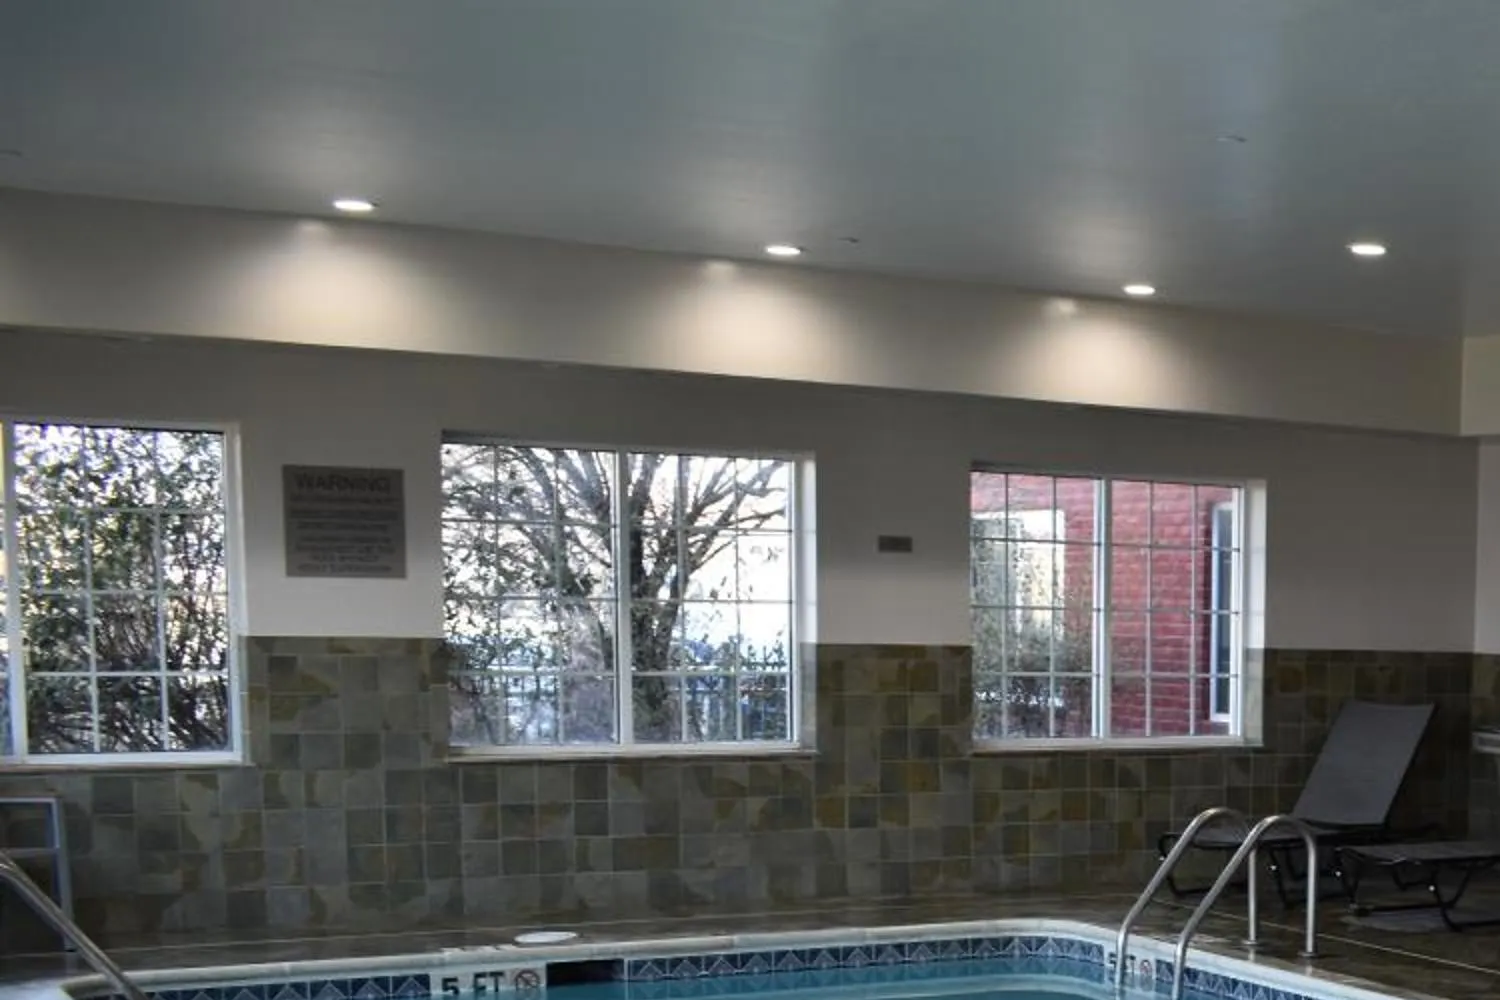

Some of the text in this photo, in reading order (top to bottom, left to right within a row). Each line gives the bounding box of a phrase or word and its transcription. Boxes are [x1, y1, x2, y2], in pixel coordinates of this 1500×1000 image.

[295, 473, 391, 492] WARNING
[441, 971, 504, 996] 5 FT
